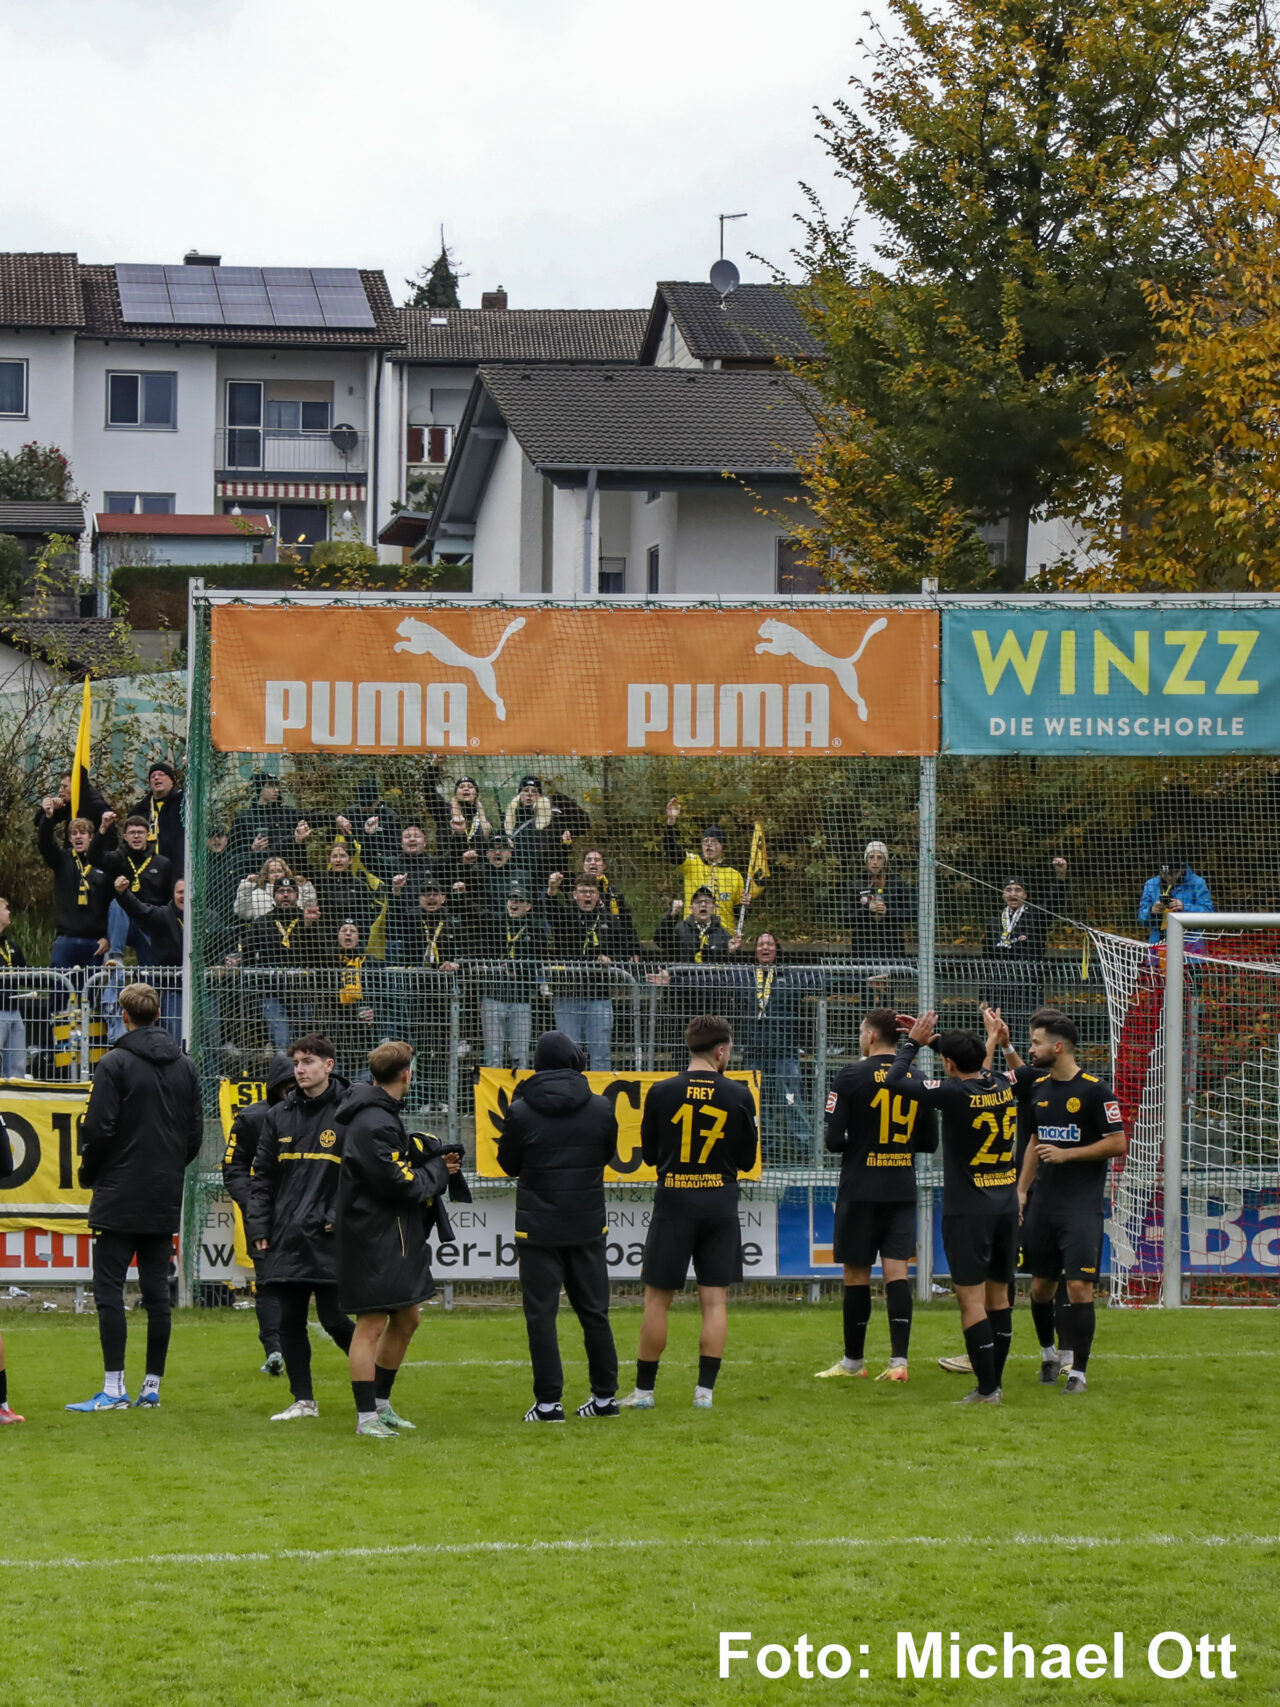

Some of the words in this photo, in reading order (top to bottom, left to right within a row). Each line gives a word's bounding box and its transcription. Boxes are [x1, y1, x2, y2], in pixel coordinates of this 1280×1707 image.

[972, 629, 1260, 695] WINZZ
[265, 681, 469, 746] PUMA
[627, 683, 831, 748] PUMA
[989, 717, 1033, 736] DIE
[1044, 717, 1245, 736] WEINSCHORLE
[686, 1086, 715, 1100] FREY
[671, 1103, 728, 1164] 17
[1037, 1124, 1081, 1142] maxit
[674, 1180, 724, 1188] BRAUHAUS
